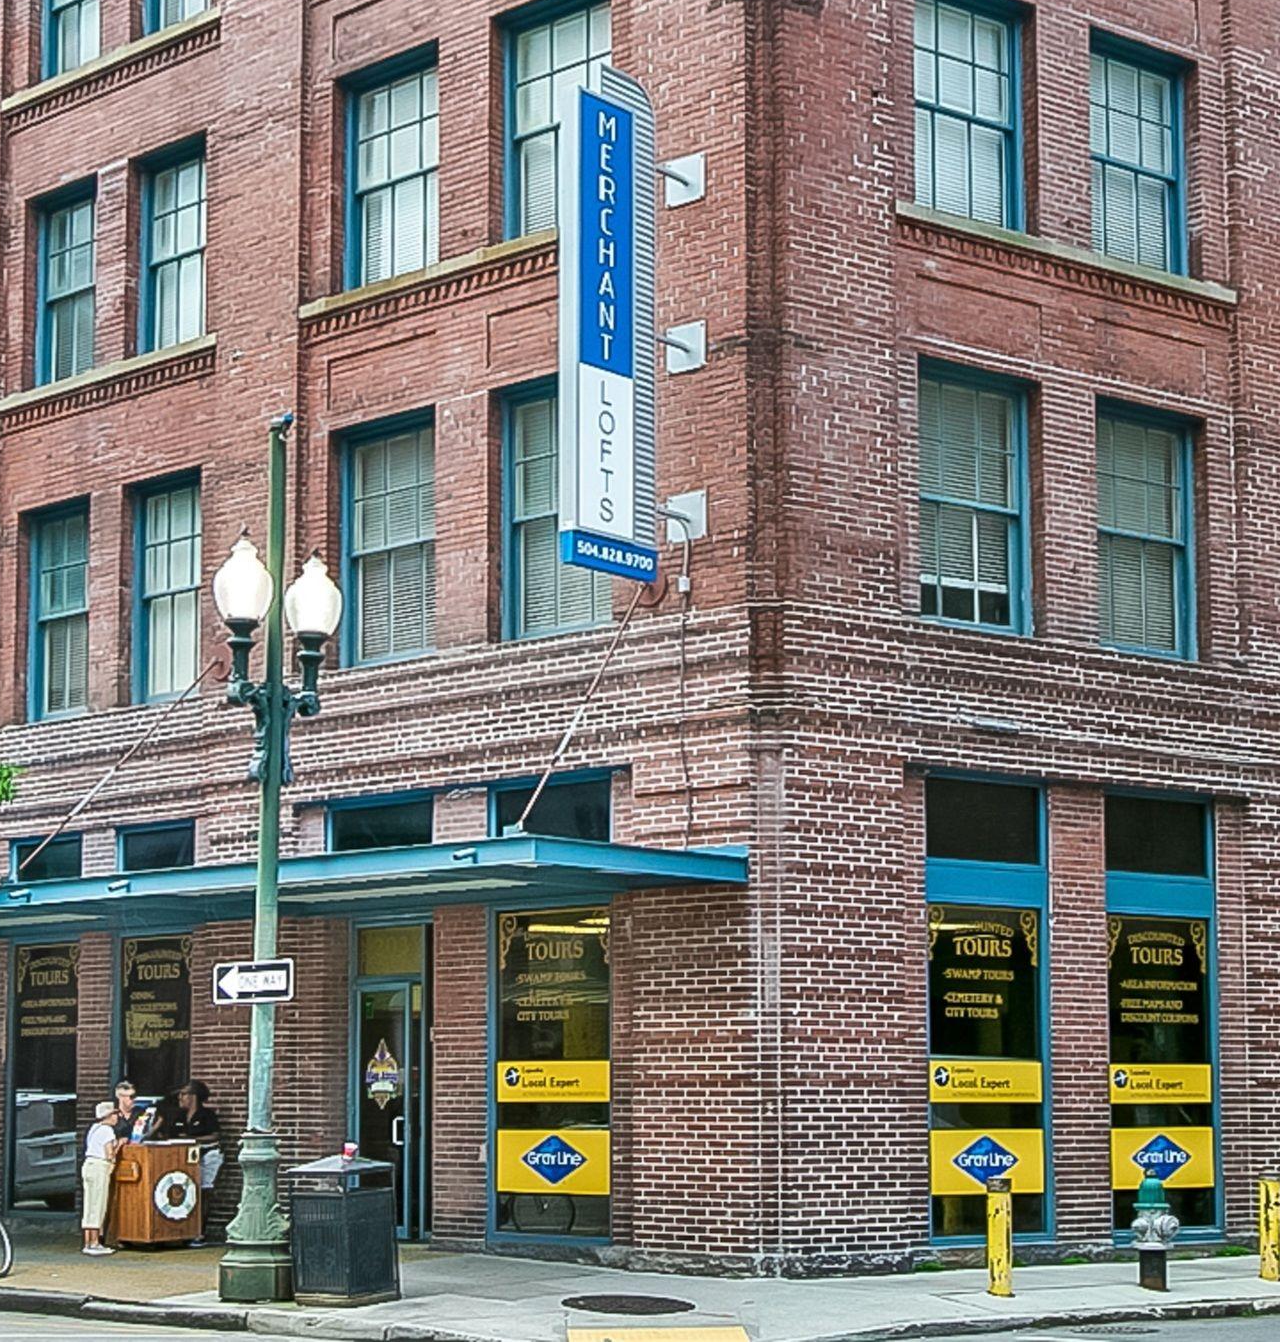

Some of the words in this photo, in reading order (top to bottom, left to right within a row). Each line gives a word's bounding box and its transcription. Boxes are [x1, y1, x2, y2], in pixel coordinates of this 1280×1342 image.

[597, 109, 618, 362] MERCHANT
[598, 379, 617, 524] LOFTS
[576, 539, 654, 572] 504.828.9700
[525, 939, 584, 961] TOURS
[952, 936, 1013, 958] TOURS
[1130, 946, 1184, 966] TOURS
[29, 969, 70, 987] TOURS
[136, 963, 181, 981] TOURS
[522, 1076, 547, 1089] Local
[549, 1076, 581, 1090] Expert
[951, 1076, 978, 1089] Local
[980, 1076, 1011, 1090] Expert
[1130, 1079, 1153, 1090] Local
[1155, 1078, 1184, 1091] Expert
